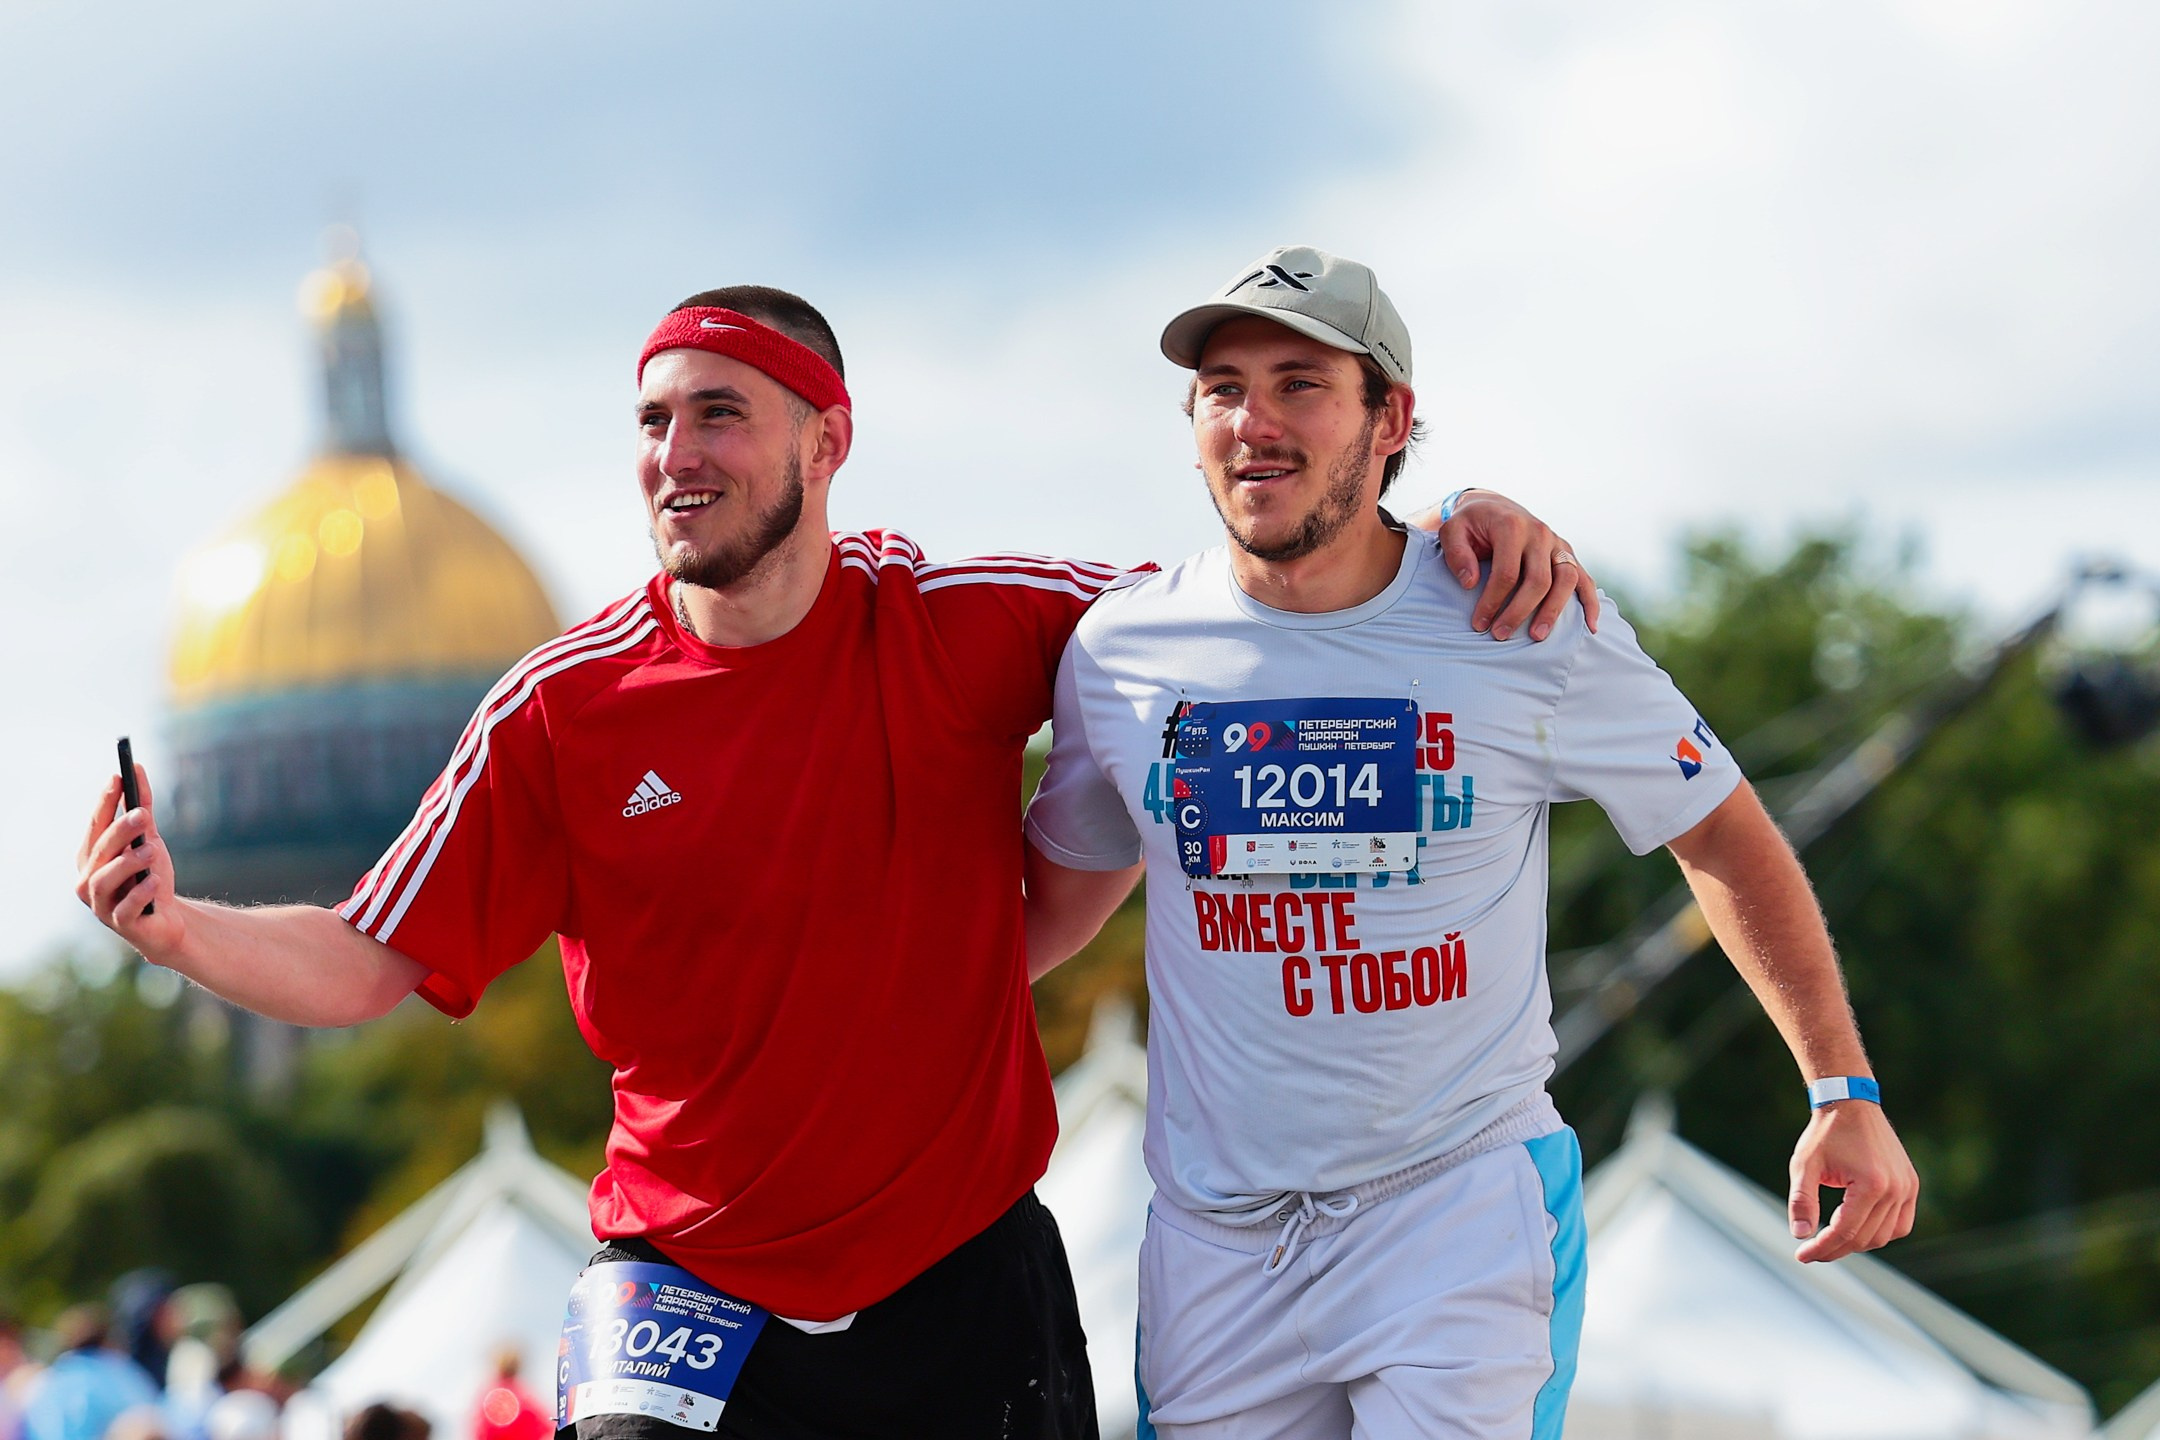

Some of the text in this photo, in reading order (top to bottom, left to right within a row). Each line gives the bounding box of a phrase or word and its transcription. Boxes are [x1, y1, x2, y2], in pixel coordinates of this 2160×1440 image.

[1191, 726, 1208, 736] ВТБ
[1299, 717, 1397, 730] ПЕТЕРБУРГСКИЙ
[1223, 721, 1272, 753] 99
[1298, 741, 1396, 751] ПУШКИН ПЕТЕРБУРГ
[1299, 731, 1359, 742] МАРАФОН
[1234, 763, 1382, 809] 12014
[622, 792, 682, 817] adidas
[1261, 811, 1345, 828] МАКСИМ
[1184, 841, 1202, 855] 30
[1193, 890, 1361, 954] ВМЕСТЕ
[1320, 931, 1468, 1015] ТОБОЙ
[656, 1293, 713, 1314] МАРАФОН
[660, 1284, 752, 1315] ПЕТЕРБУРГСКИЙ
[652, 1303, 743, 1330] ПУШКИН ПЕТЕРБУРГ
[604, 1360, 671, 1379] ИТАЛИЙ
